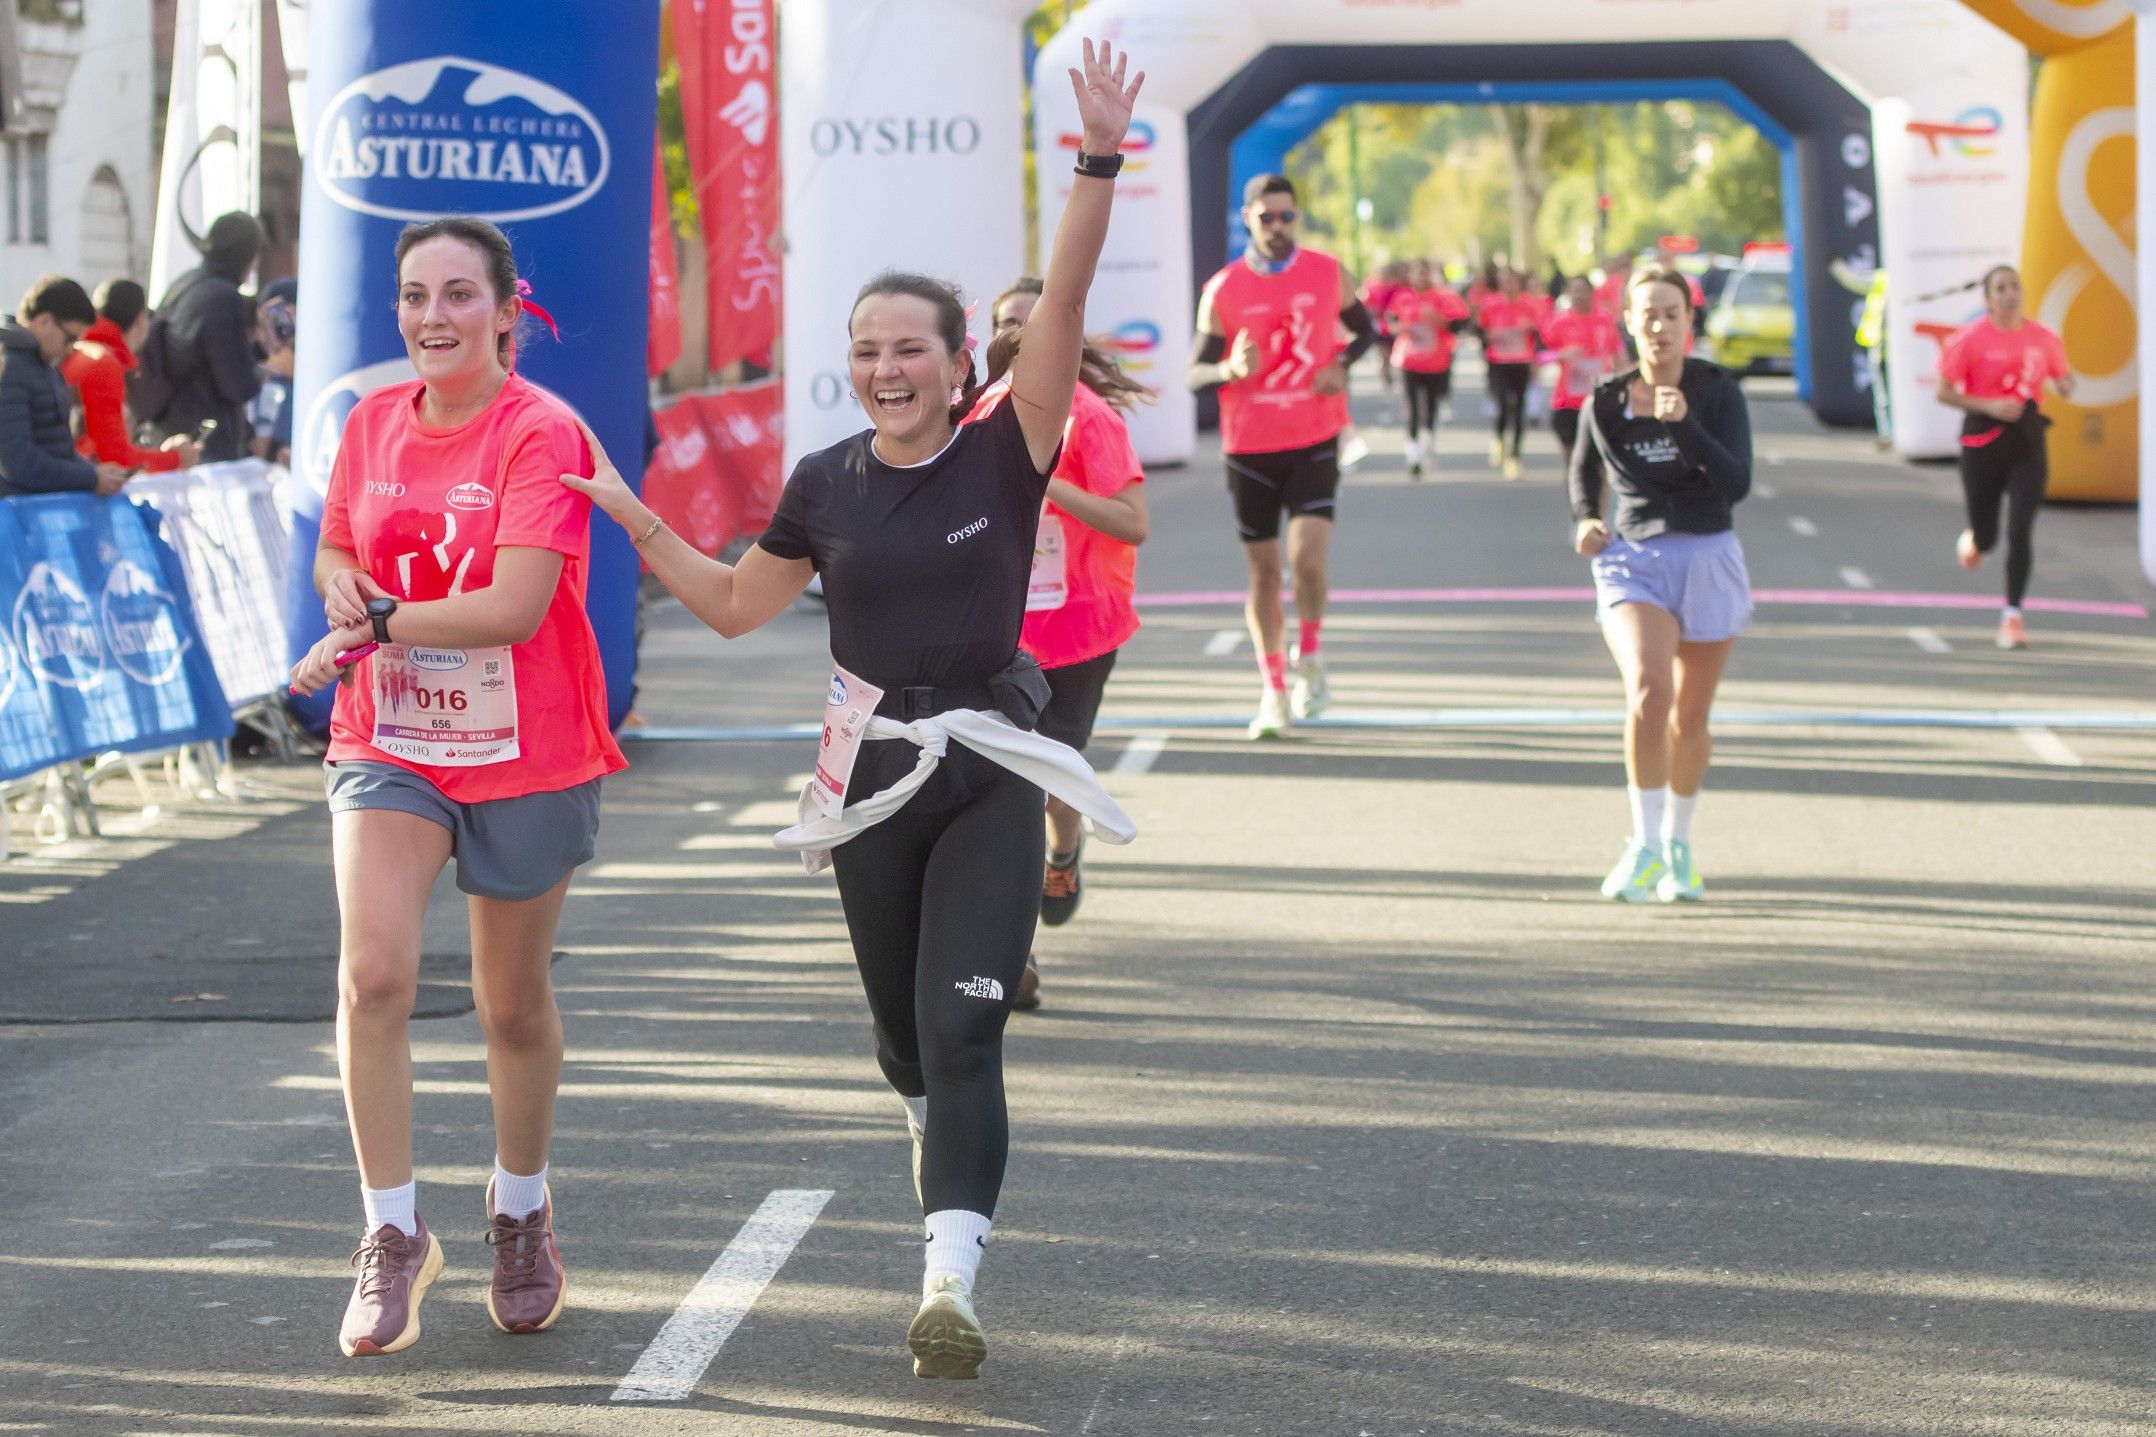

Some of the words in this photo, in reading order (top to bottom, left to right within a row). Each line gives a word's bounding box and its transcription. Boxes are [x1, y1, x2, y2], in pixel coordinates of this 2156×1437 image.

[361, 112, 462, 132] CENTRAL
[473, 115, 582, 139] LECHERA
[810, 114, 982, 158] OYSHO
[326, 115, 588, 188] ASTURIANA
[947, 517, 988, 544] OYSHO
[411, 647, 464, 664] ASTURIANA
[416, 687, 468, 711] 016
[431, 719, 451, 729] 656
[394, 728, 420, 738] CARRERA
[420, 731, 428, 739] DE
[467, 732, 496, 741] SEVILLA
[388, 743, 430, 757] OYSHO
[457, 747, 501, 758] Santander
[955, 981, 990, 993] NORTH
[972, 976, 991, 986] THE
[964, 989, 989, 998] FACE
